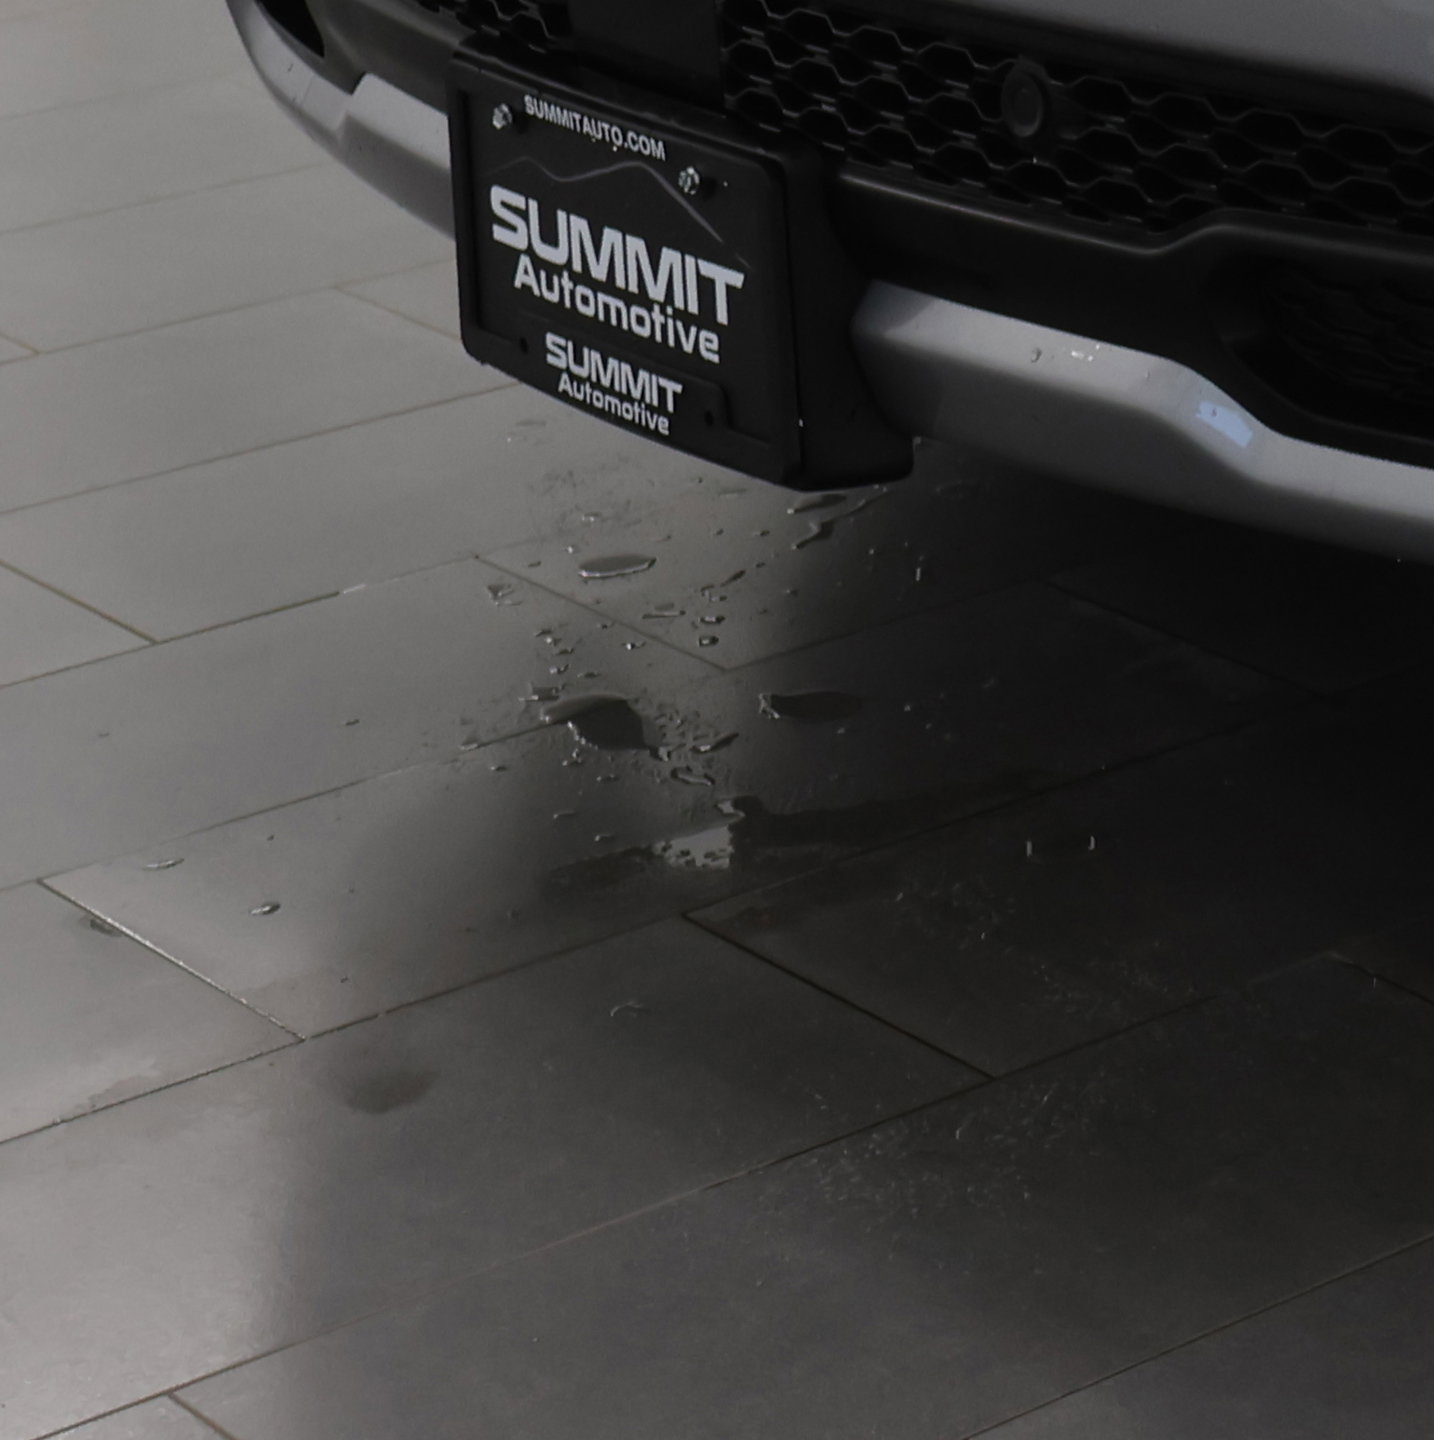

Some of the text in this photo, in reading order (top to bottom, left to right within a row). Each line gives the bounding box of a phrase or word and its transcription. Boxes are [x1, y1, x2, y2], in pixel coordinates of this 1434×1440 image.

[524, 94, 666, 161] SUMMITAUTO.COM
[490, 185, 744, 325] SUMMIT
[514, 254, 720, 364] Automotive
[545, 332, 682, 413] SUMMIT
[558, 372, 670, 436] Automotive
